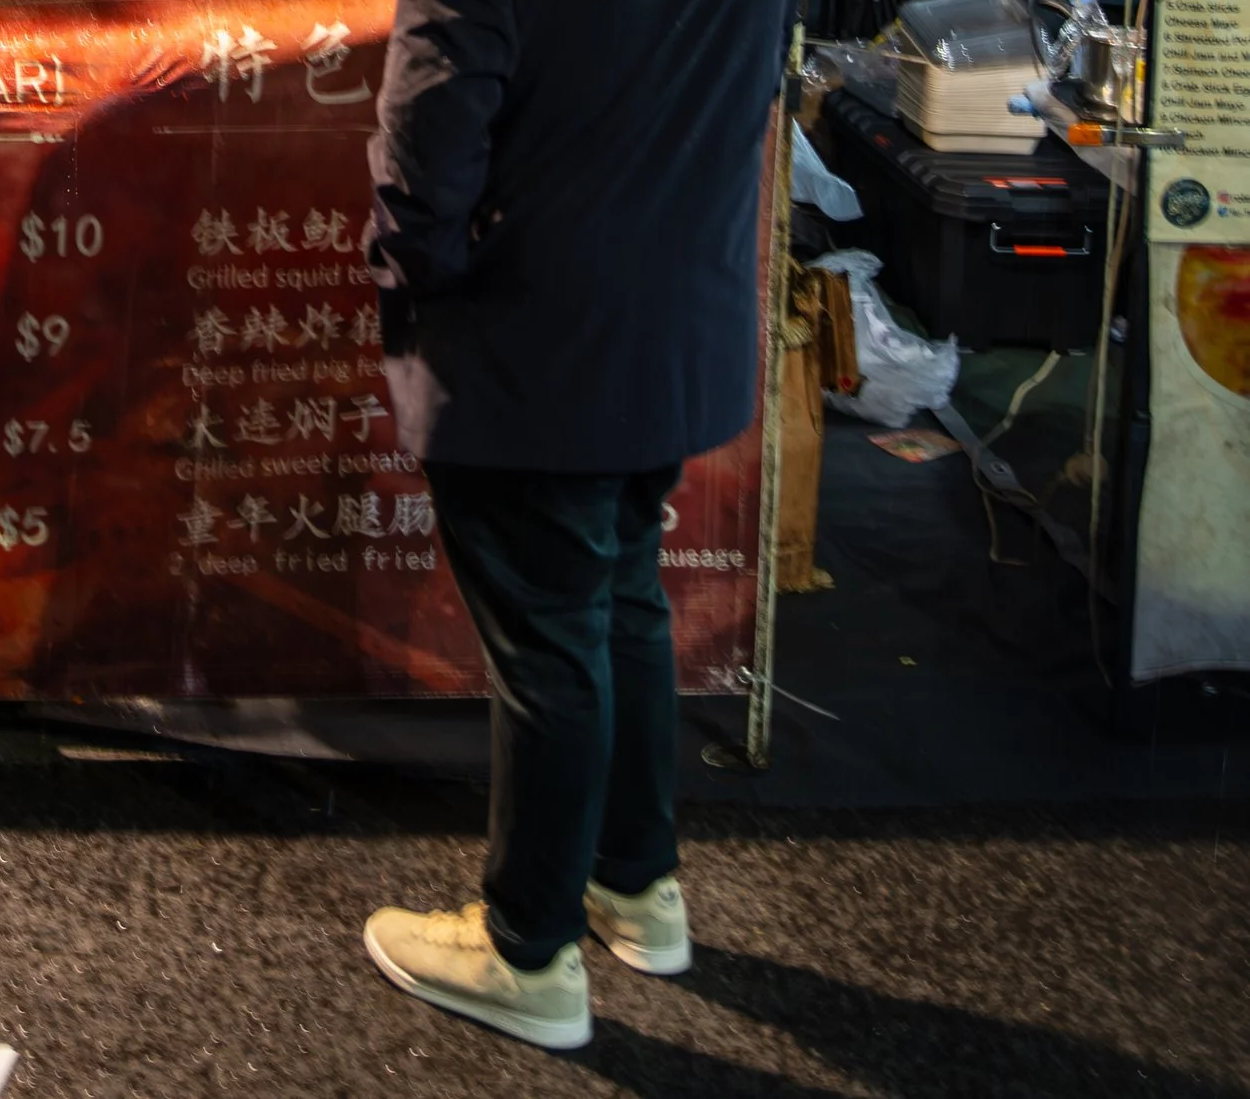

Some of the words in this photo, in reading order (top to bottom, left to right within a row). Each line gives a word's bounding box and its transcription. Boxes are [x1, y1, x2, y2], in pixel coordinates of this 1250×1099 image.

[20, 212, 104, 264] $10
[191, 206, 364, 255] 铁板鱿
[187, 263, 270, 291] Grilled
[275, 261, 340, 292] squid
[15, 311, 71, 363] $9
[261, 450, 333, 476] sweet
[274, 546, 349, 573] fried
[361, 543, 438, 571] fried
